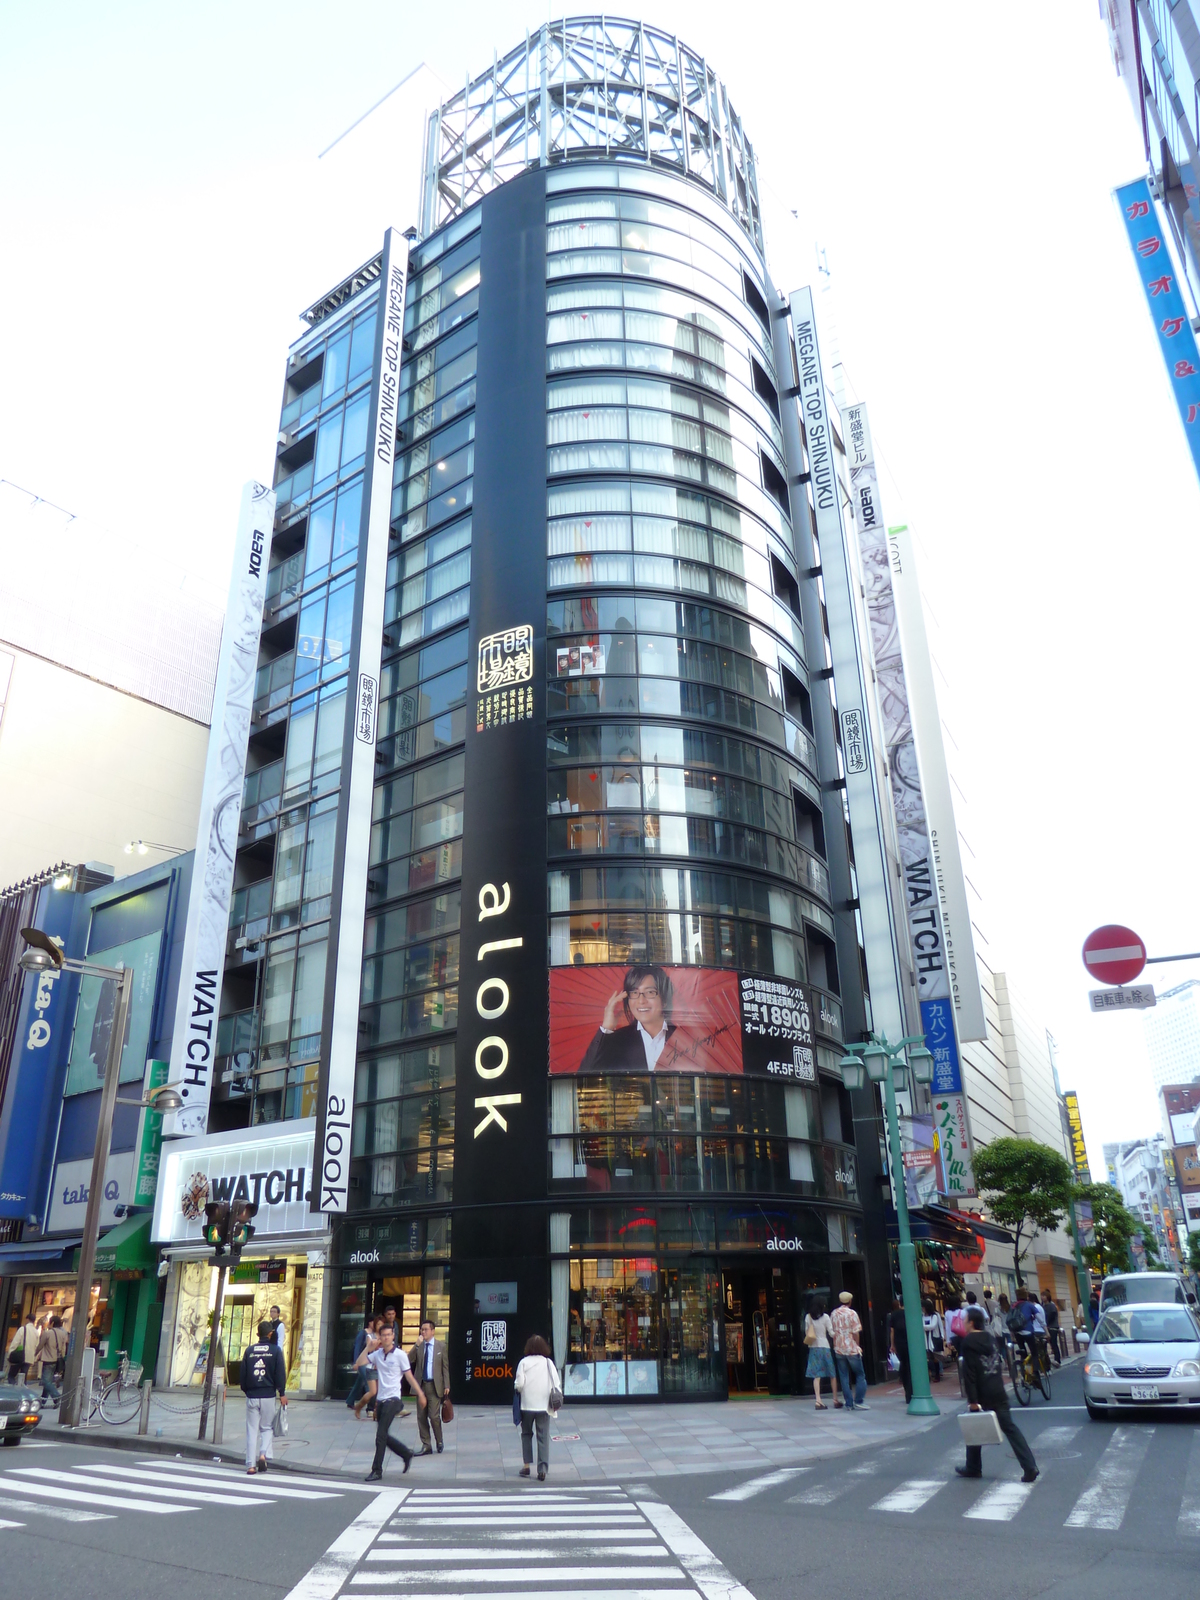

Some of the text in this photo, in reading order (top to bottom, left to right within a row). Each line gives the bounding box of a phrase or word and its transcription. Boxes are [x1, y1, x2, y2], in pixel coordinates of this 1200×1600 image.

[377, 264, 404, 465] MEGANE TOP SHINJUKU
[797, 320, 834, 510] MEGANE TOP SHINJUKU
[848, 408, 867, 464] 新盛堂ビル
[359, 677, 374, 741] 眼鏡市場
[845, 712, 864, 770] 眼鏡市場
[27, 935, 65, 1050] tka-Q
[1093, 990, 1151, 1007] 自転車を除く
[474, 881, 523, 1139] alook
[744, 1013, 760, 1021] 一式
[760, 1005, 810, 1031] 18900
[820, 1010, 839, 1028] alook
[745, 1022, 812, 1044] オール イン ワンプライス
[928, 1004, 954, 1091] カバン 新盛堂
[767, 1061, 793, 1077] 4F.5F
[1066, 1096, 1088, 1171] 新宿ライオン
[321, 1093, 350, 1209] alook
[835, 1168, 854, 1184] alook
[0, 1192, 27, 1201] タカキュー
[62, 1179, 120, 1205] takQ
[350, 1249, 380, 1263] alook
[767, 1236, 803, 1251] alook
[474, 1363, 513, 1378] alook
